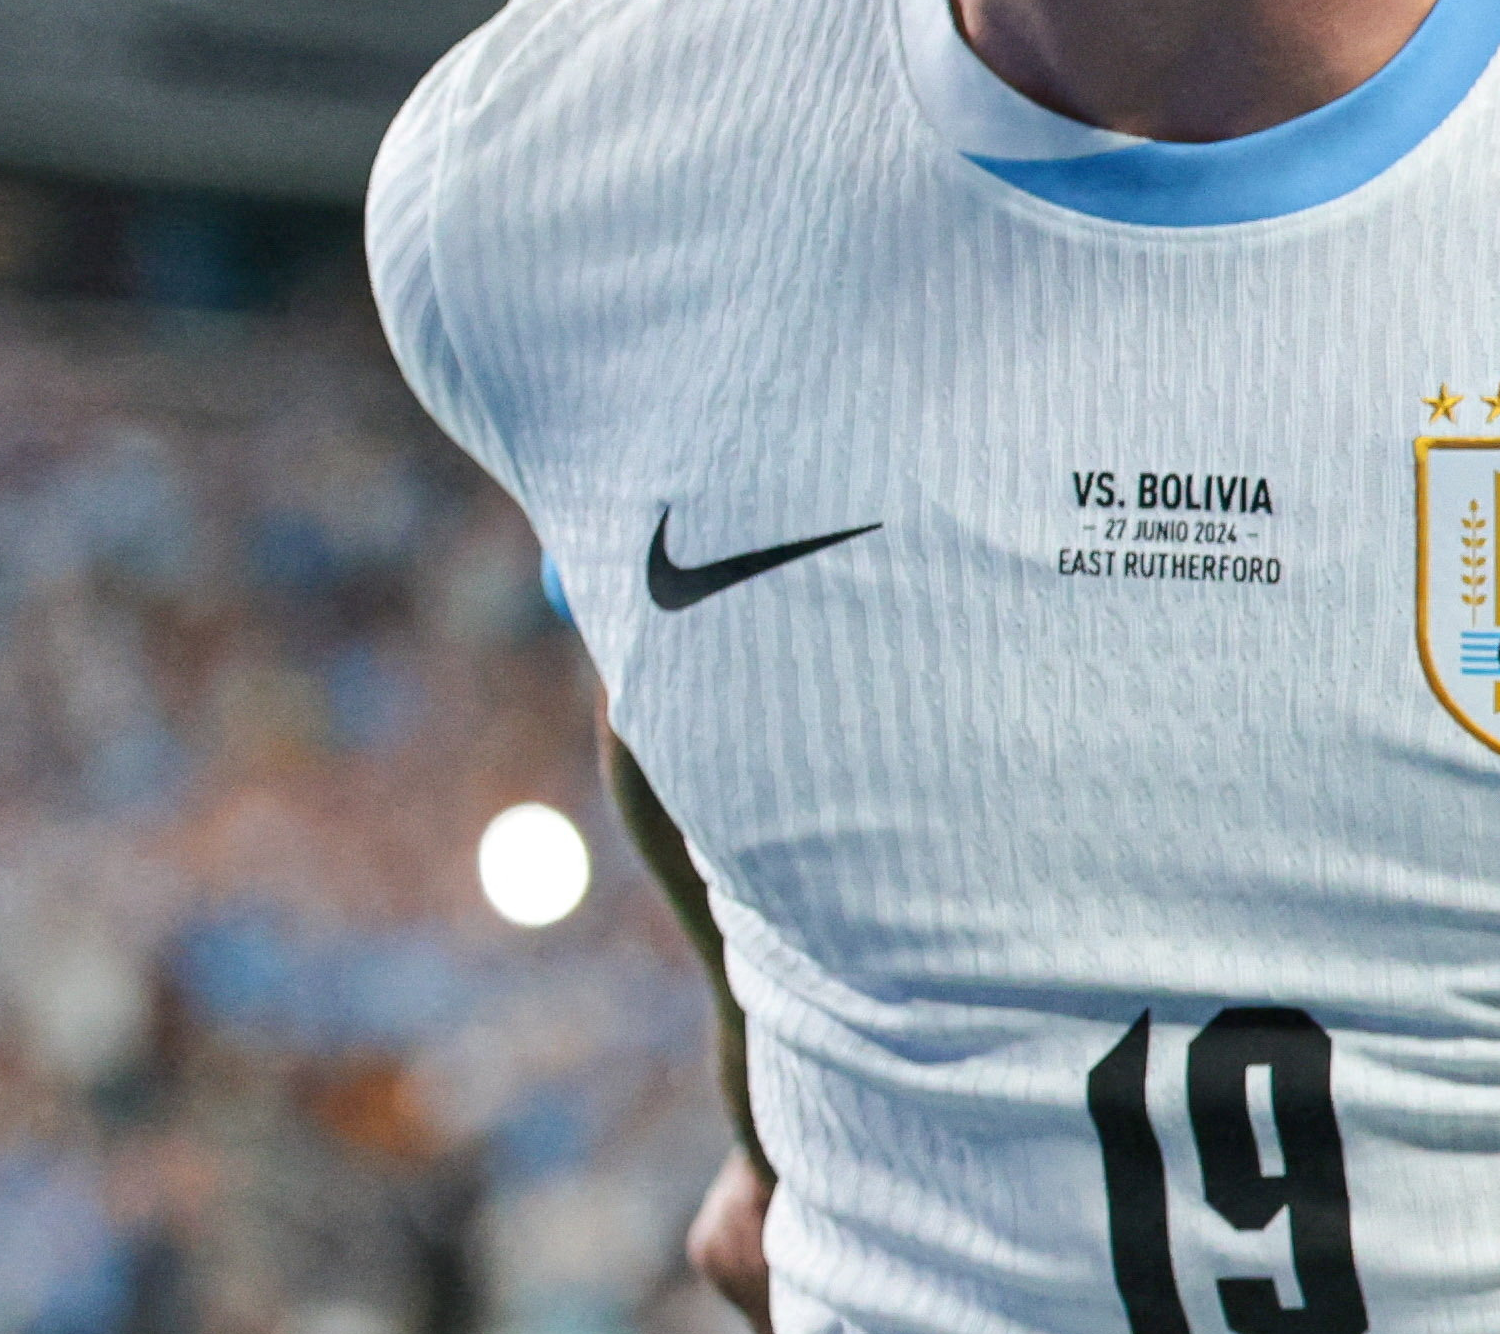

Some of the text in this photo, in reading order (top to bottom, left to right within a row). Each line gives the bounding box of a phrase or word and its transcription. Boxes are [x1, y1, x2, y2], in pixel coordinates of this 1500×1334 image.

[1072, 471, 1273, 514] VS. BOLIVIA
[1104, 519, 1127, 540] 27
[1132, 520, 1188, 542] JUNIO
[1194, 522, 1238, 544] 2024
[1058, 548, 1282, 585] EAST RUTHERFORD
